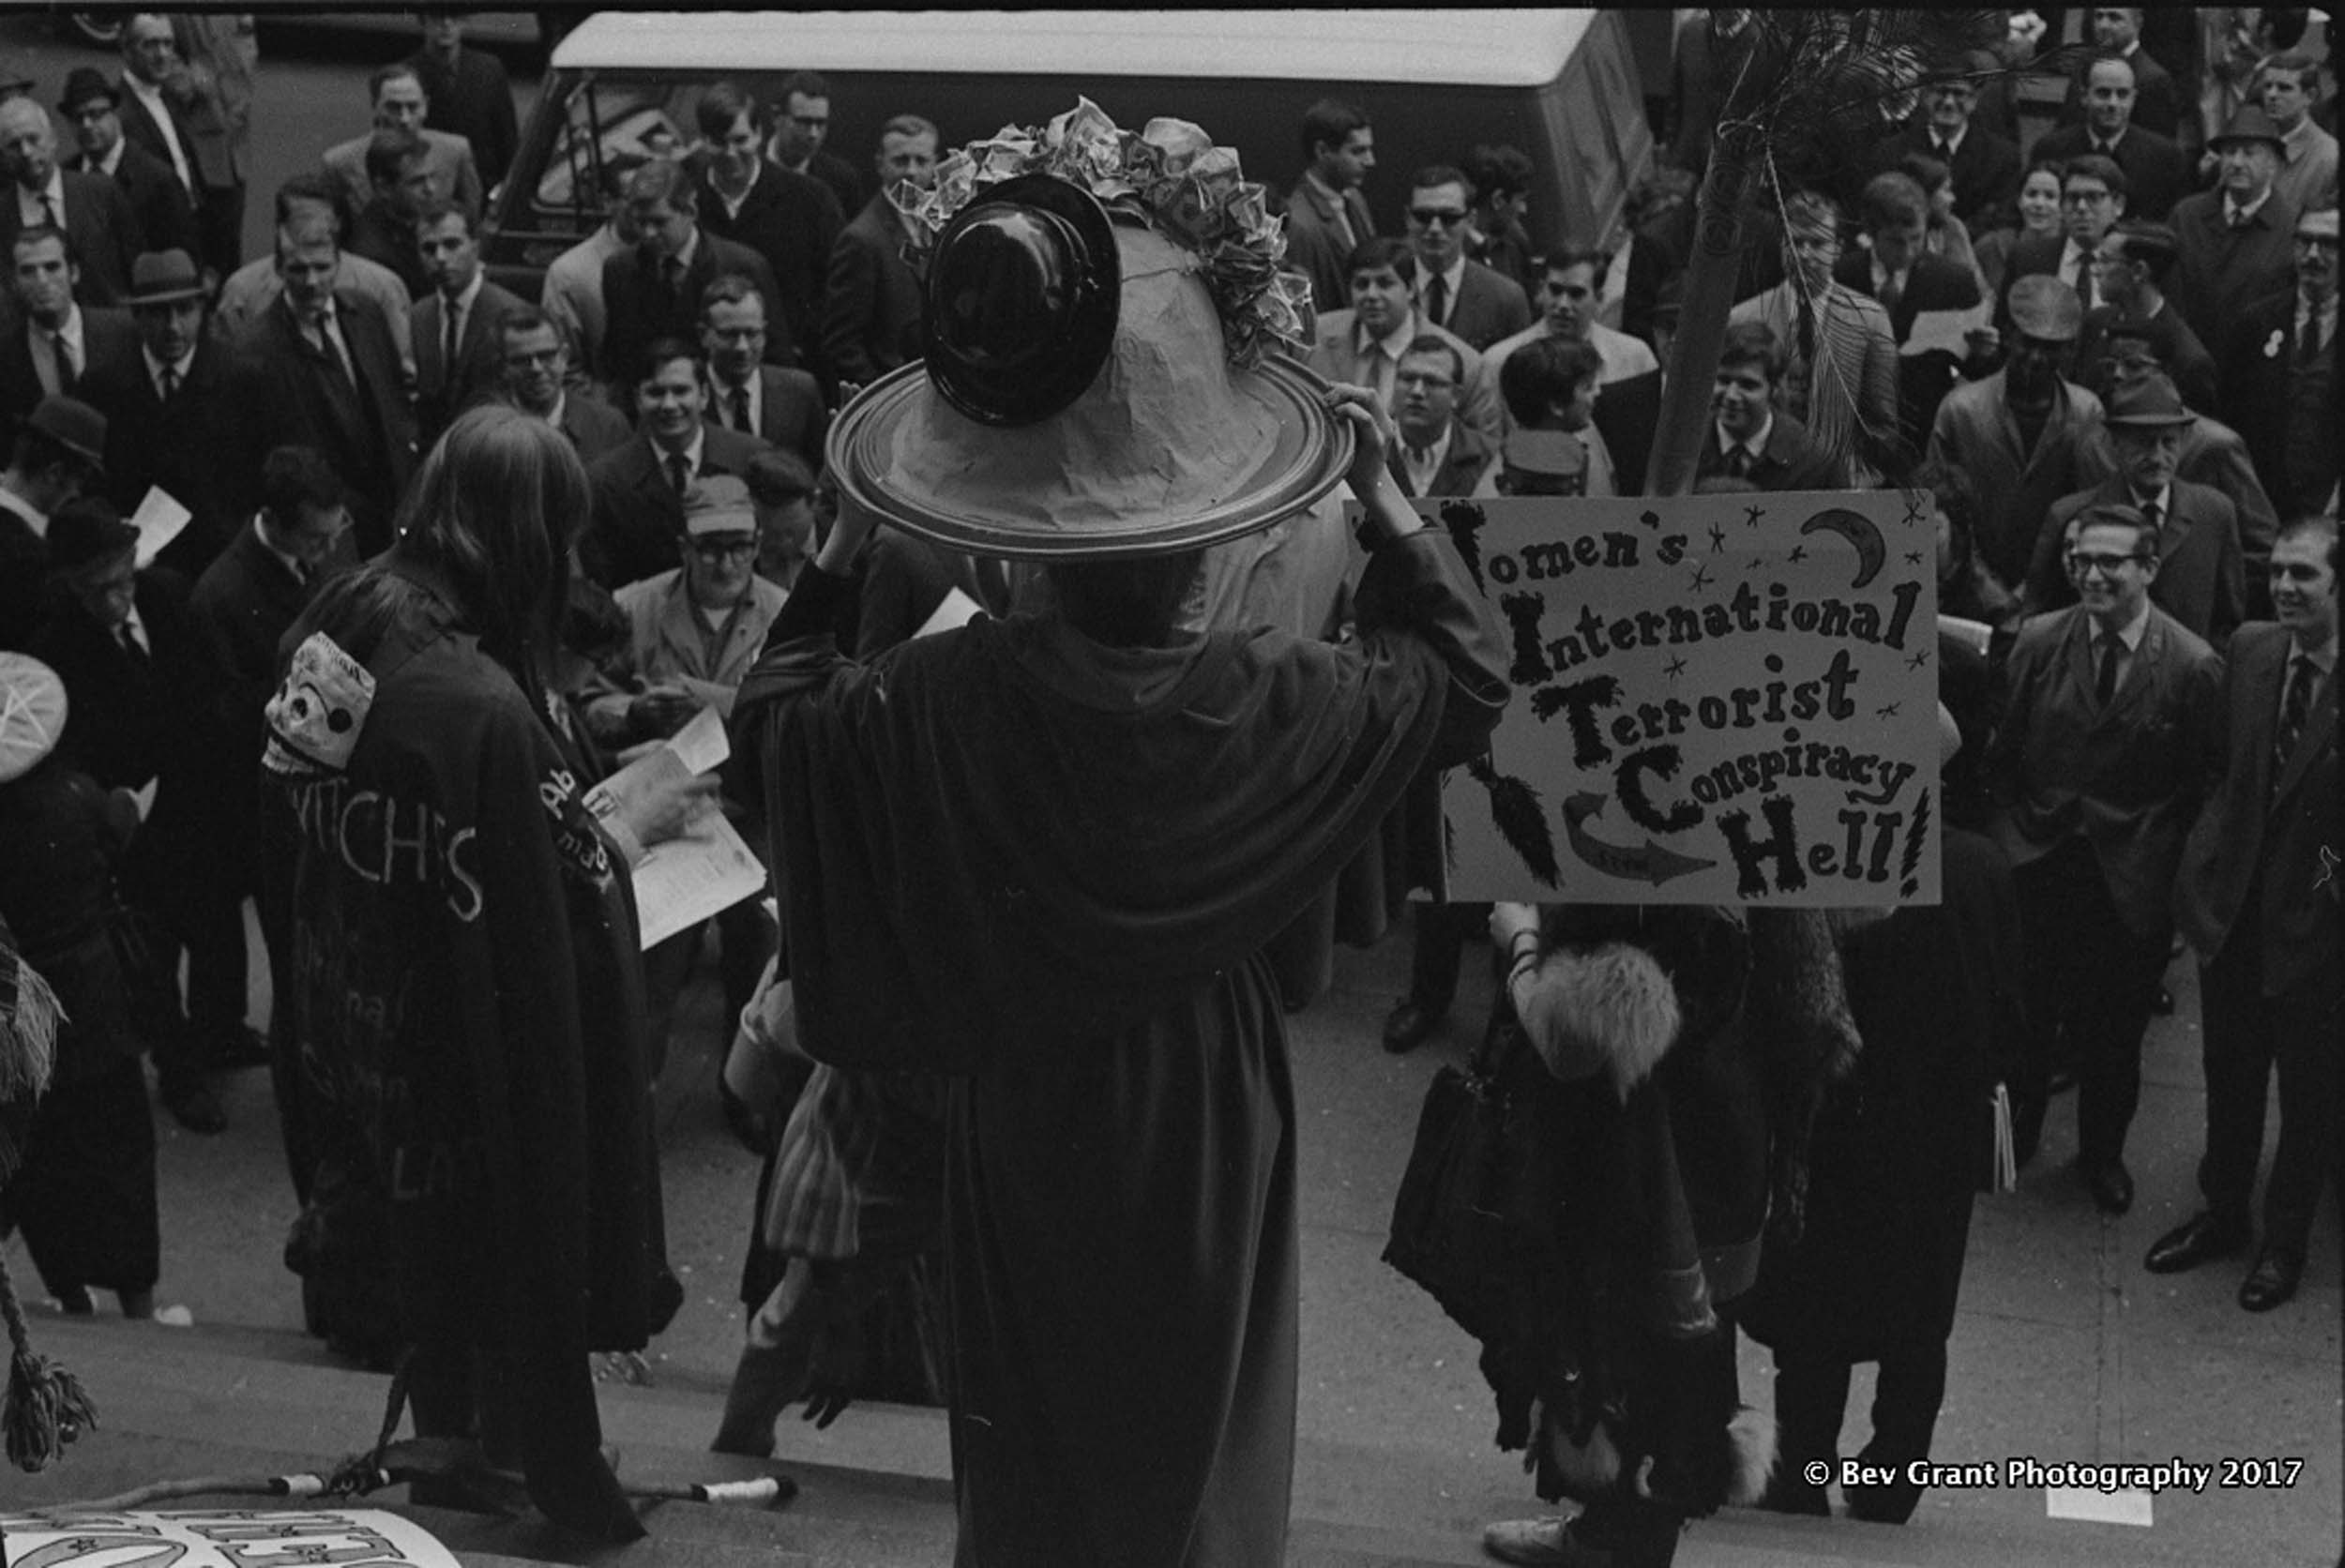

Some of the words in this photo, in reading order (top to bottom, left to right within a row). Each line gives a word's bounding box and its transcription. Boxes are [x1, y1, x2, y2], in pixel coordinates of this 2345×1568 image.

[1501, 580, 1923, 686] International
[1530, 648, 1860, 772] Terrorist
[1612, 727, 1916, 836] Conspiracy
[1715, 790, 1930, 900] Hell!
